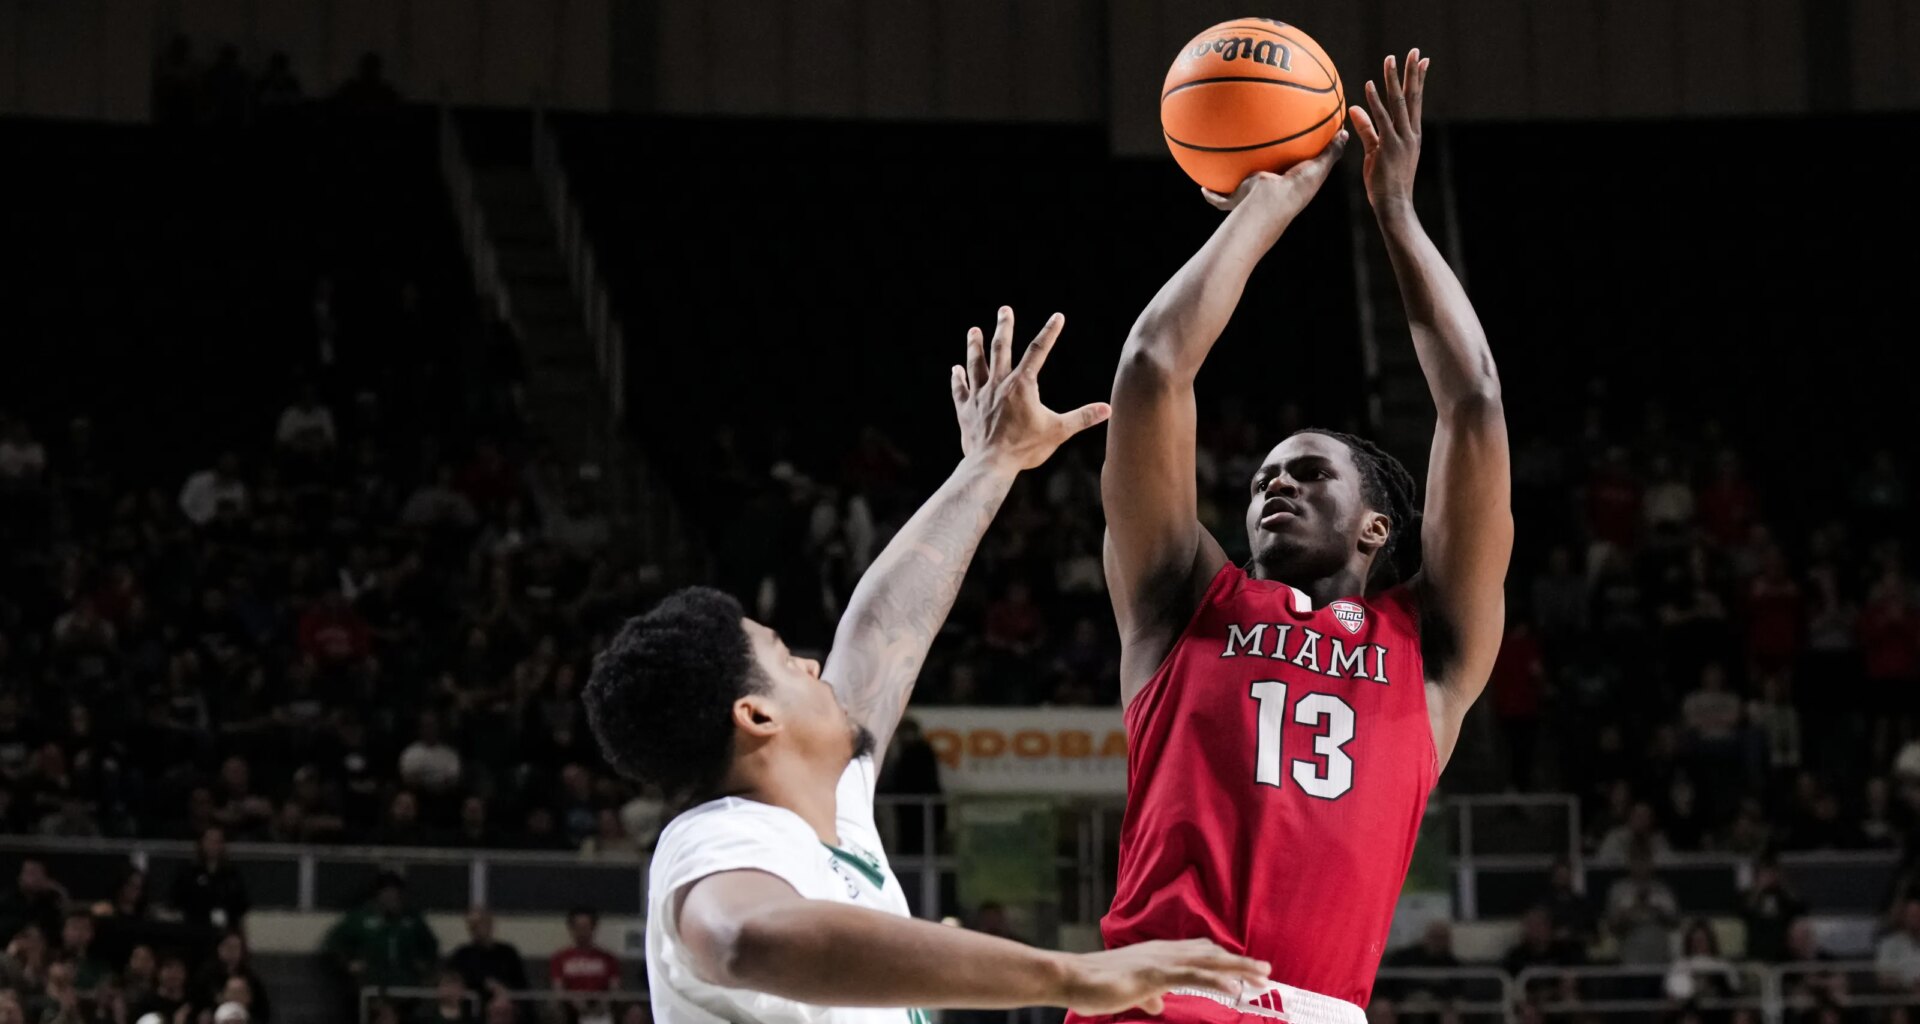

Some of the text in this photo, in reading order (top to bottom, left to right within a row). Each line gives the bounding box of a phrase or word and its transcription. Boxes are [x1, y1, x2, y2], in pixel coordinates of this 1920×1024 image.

[1335, 610, 1362, 621] MAC
[1219, 623, 1390, 686] MIAMI
[1250, 678, 1356, 801] 13
